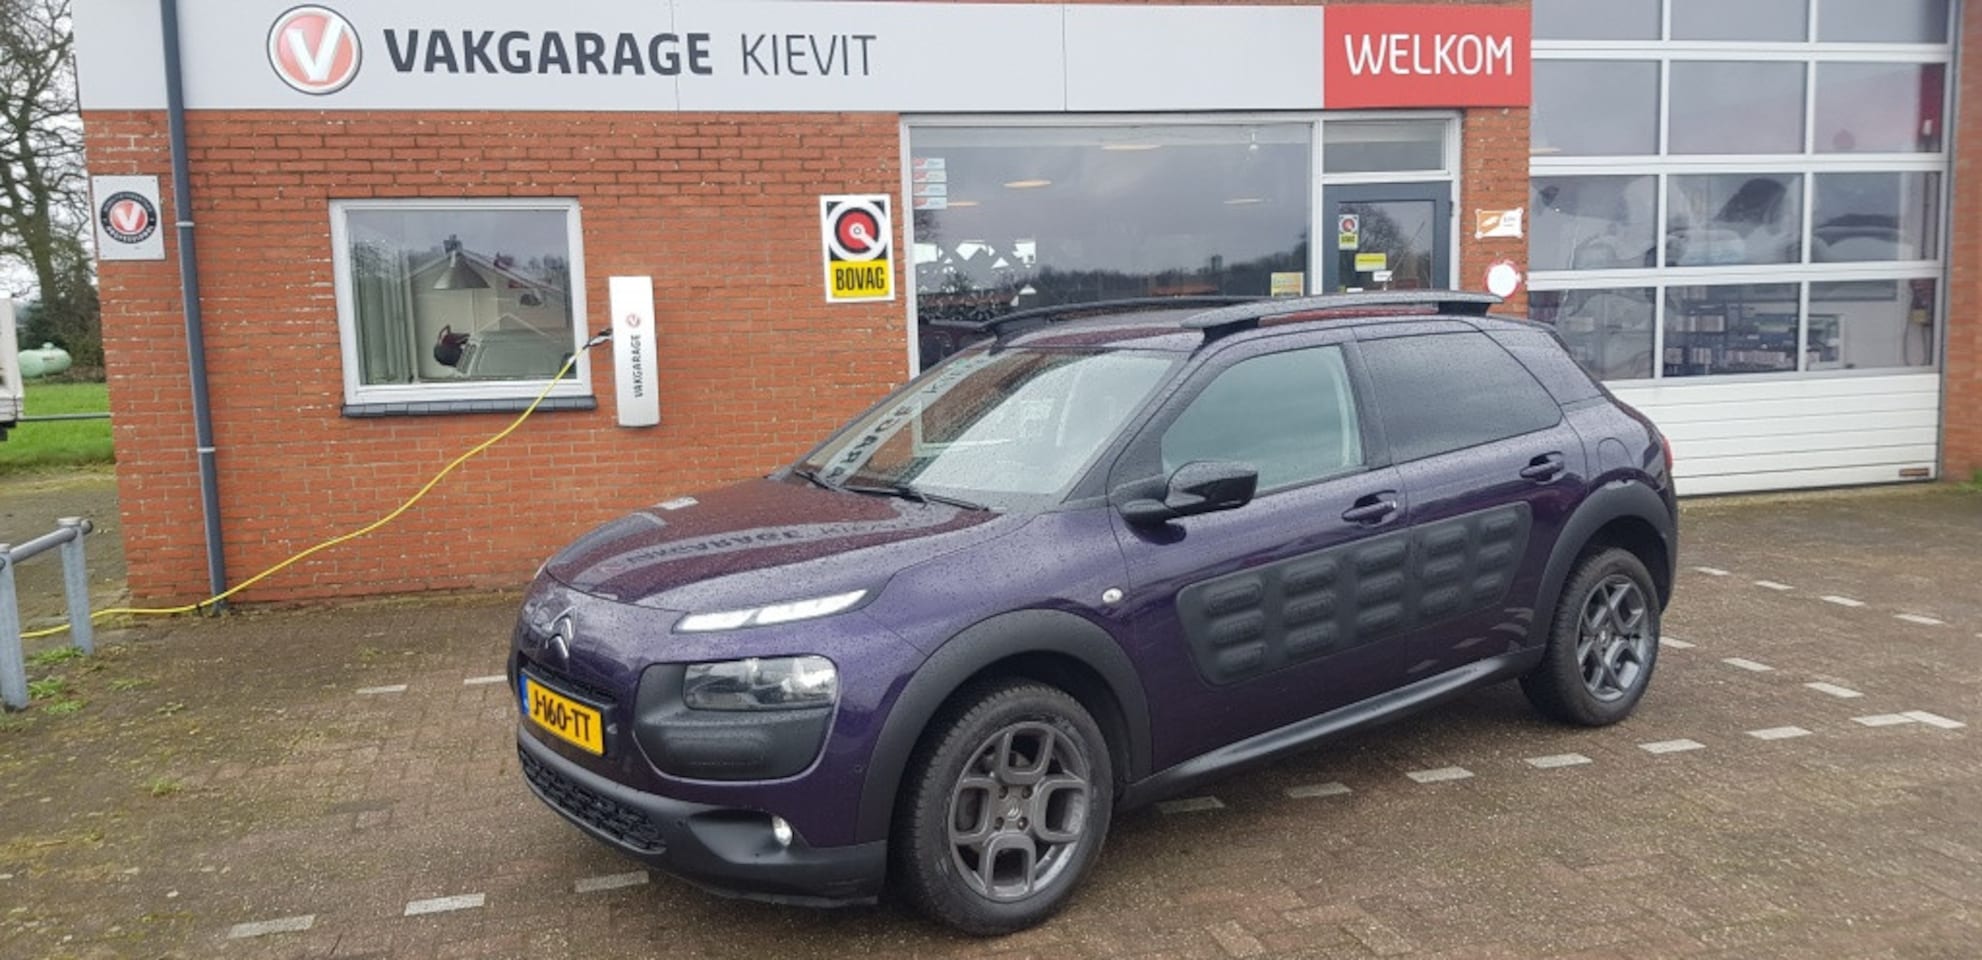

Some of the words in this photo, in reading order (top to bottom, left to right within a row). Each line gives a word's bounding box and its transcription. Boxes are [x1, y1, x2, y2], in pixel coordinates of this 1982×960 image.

[383, 28, 713, 75] VAKGARAGE
[741, 33, 877, 75] KIEVIT
[1344, 34, 1512, 75] WELKOM
[835, 266, 885, 291] BOVAG
[631, 334, 643, 398] VAKGARAGE
[534, 689, 591, 742] J-160-TT
